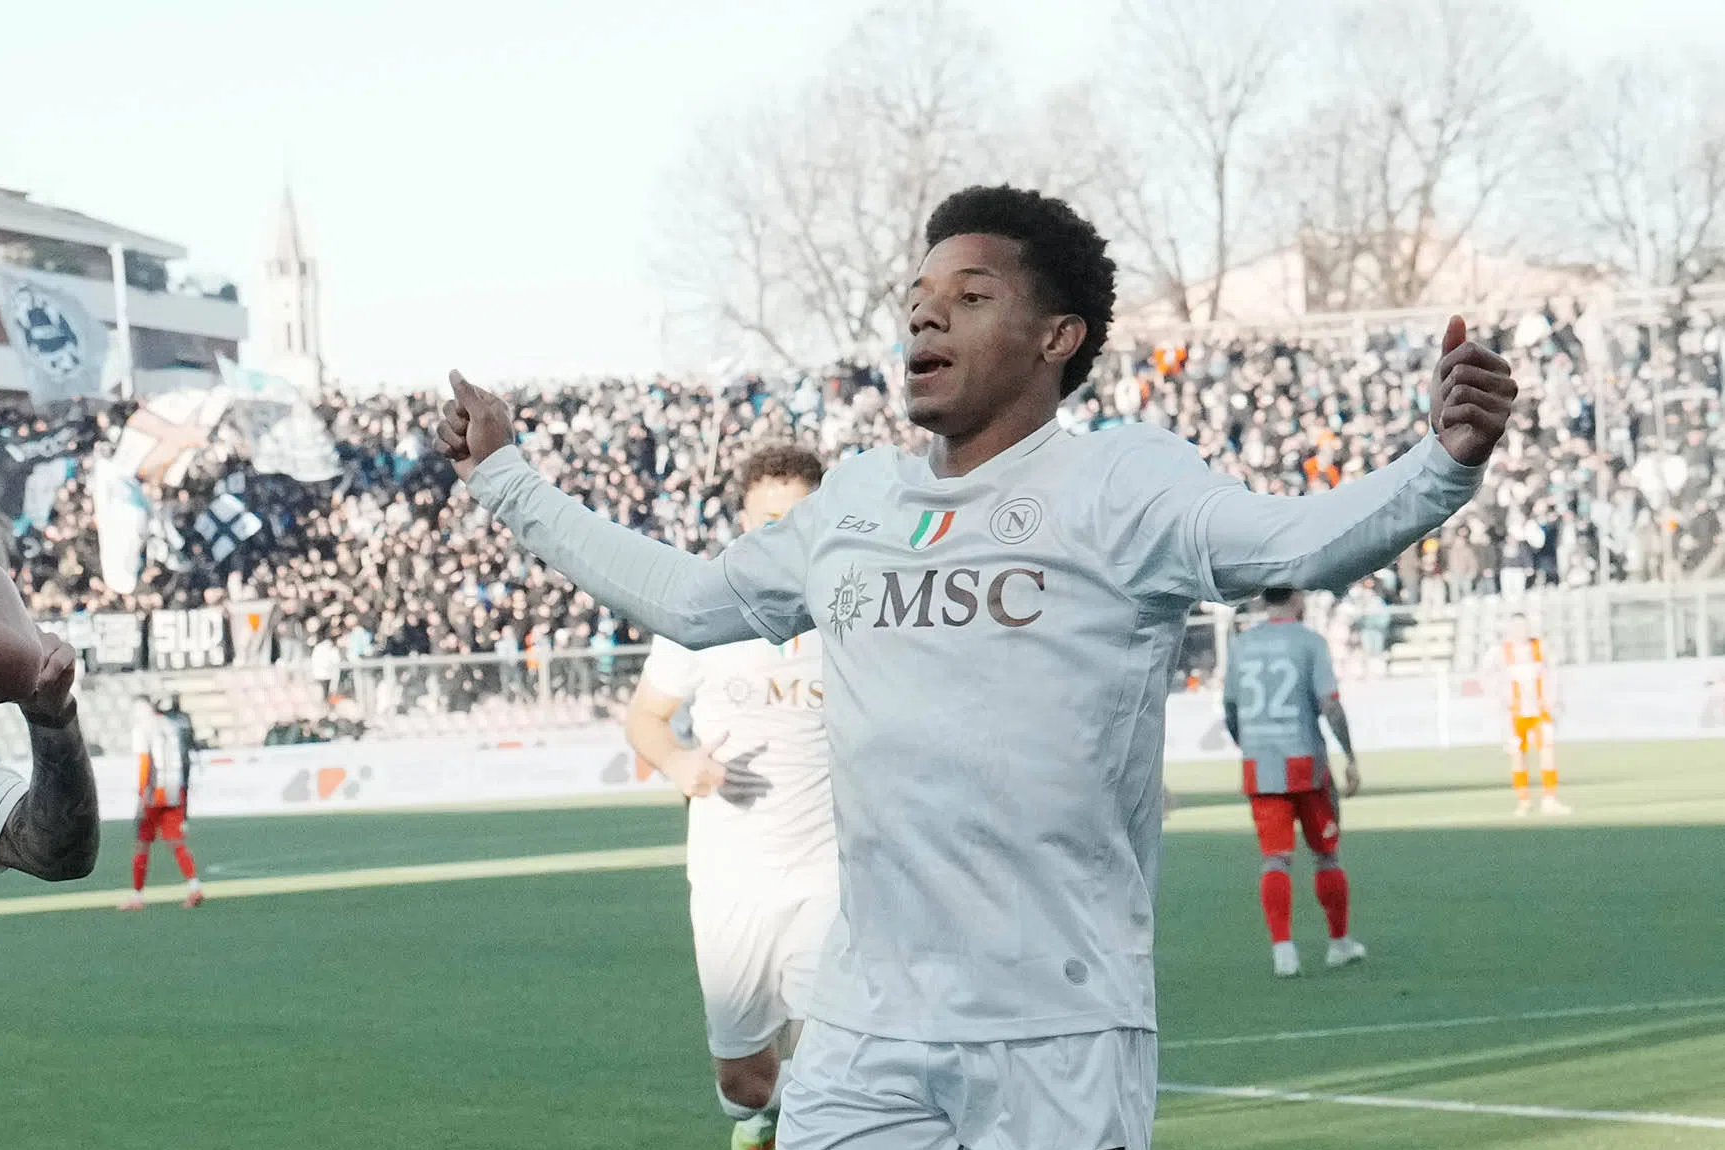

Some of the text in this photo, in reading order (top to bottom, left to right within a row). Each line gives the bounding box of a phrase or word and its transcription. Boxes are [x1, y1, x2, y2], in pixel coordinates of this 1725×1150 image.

[1004, 511, 1030, 531] N
[873, 568, 1045, 628] MSC
[1237, 658, 1299, 718] 32
